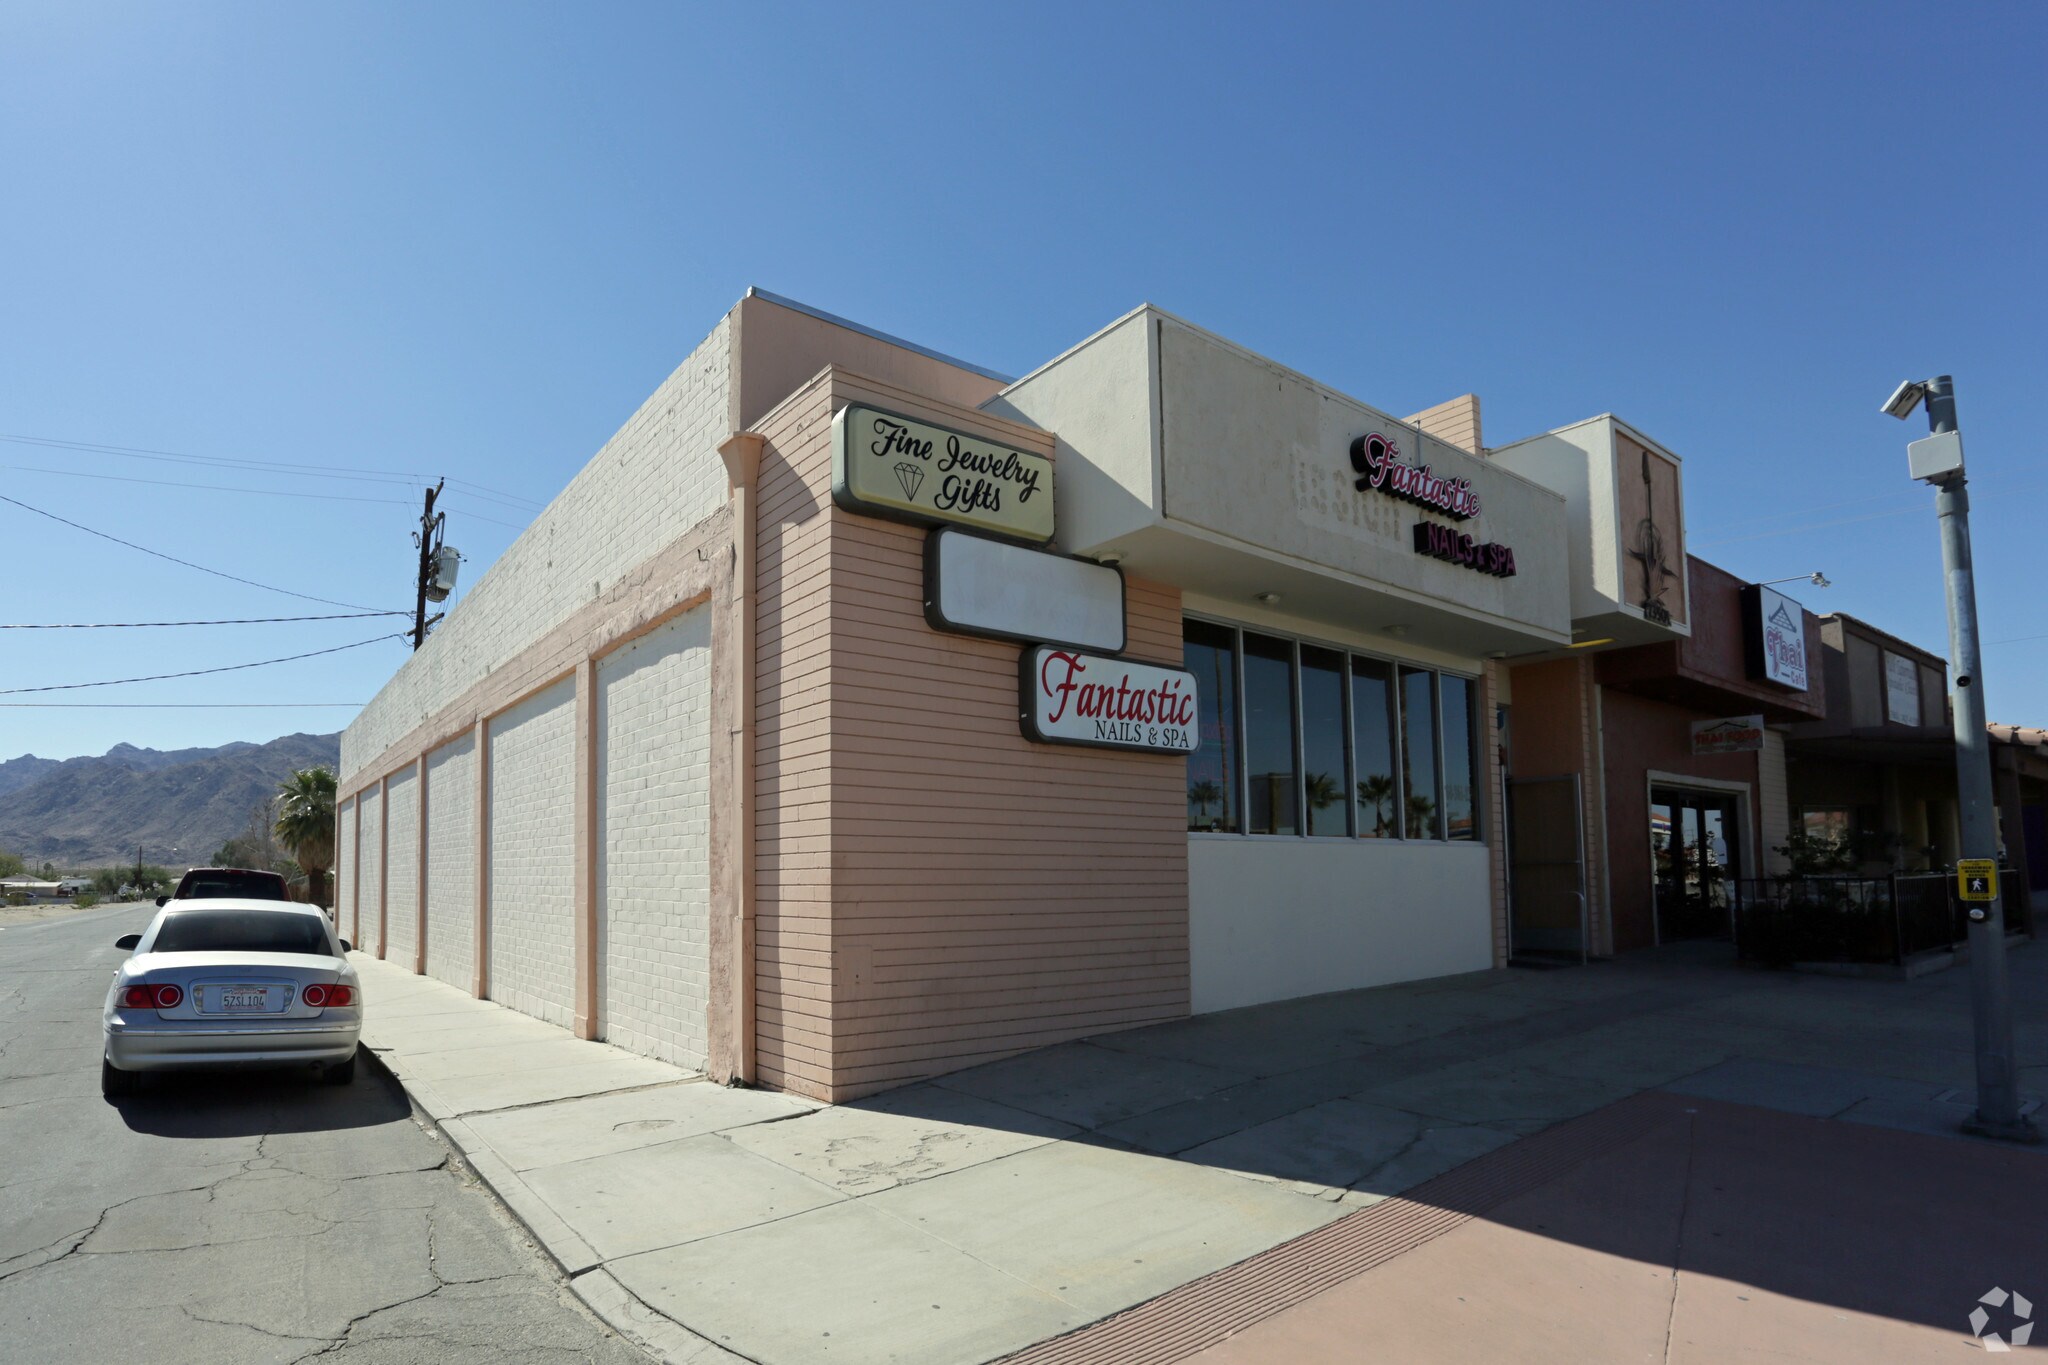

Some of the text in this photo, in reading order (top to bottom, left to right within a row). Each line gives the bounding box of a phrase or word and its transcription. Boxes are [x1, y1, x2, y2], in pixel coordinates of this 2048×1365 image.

[871, 418, 1041, 503] Fine Jewelry
[1364, 432, 1481, 518] Fantastic
[934, 475, 1001, 513] Gifts
[1427, 521, 1516, 576] NAILS & SPA
[1766, 626, 1804, 677] Thai
[1041, 651, 1194, 726] Fantastic
[1094, 720, 1142, 743] NAILS
[1148, 727, 1158, 746] &
[1162, 728, 1190, 748] SPA
